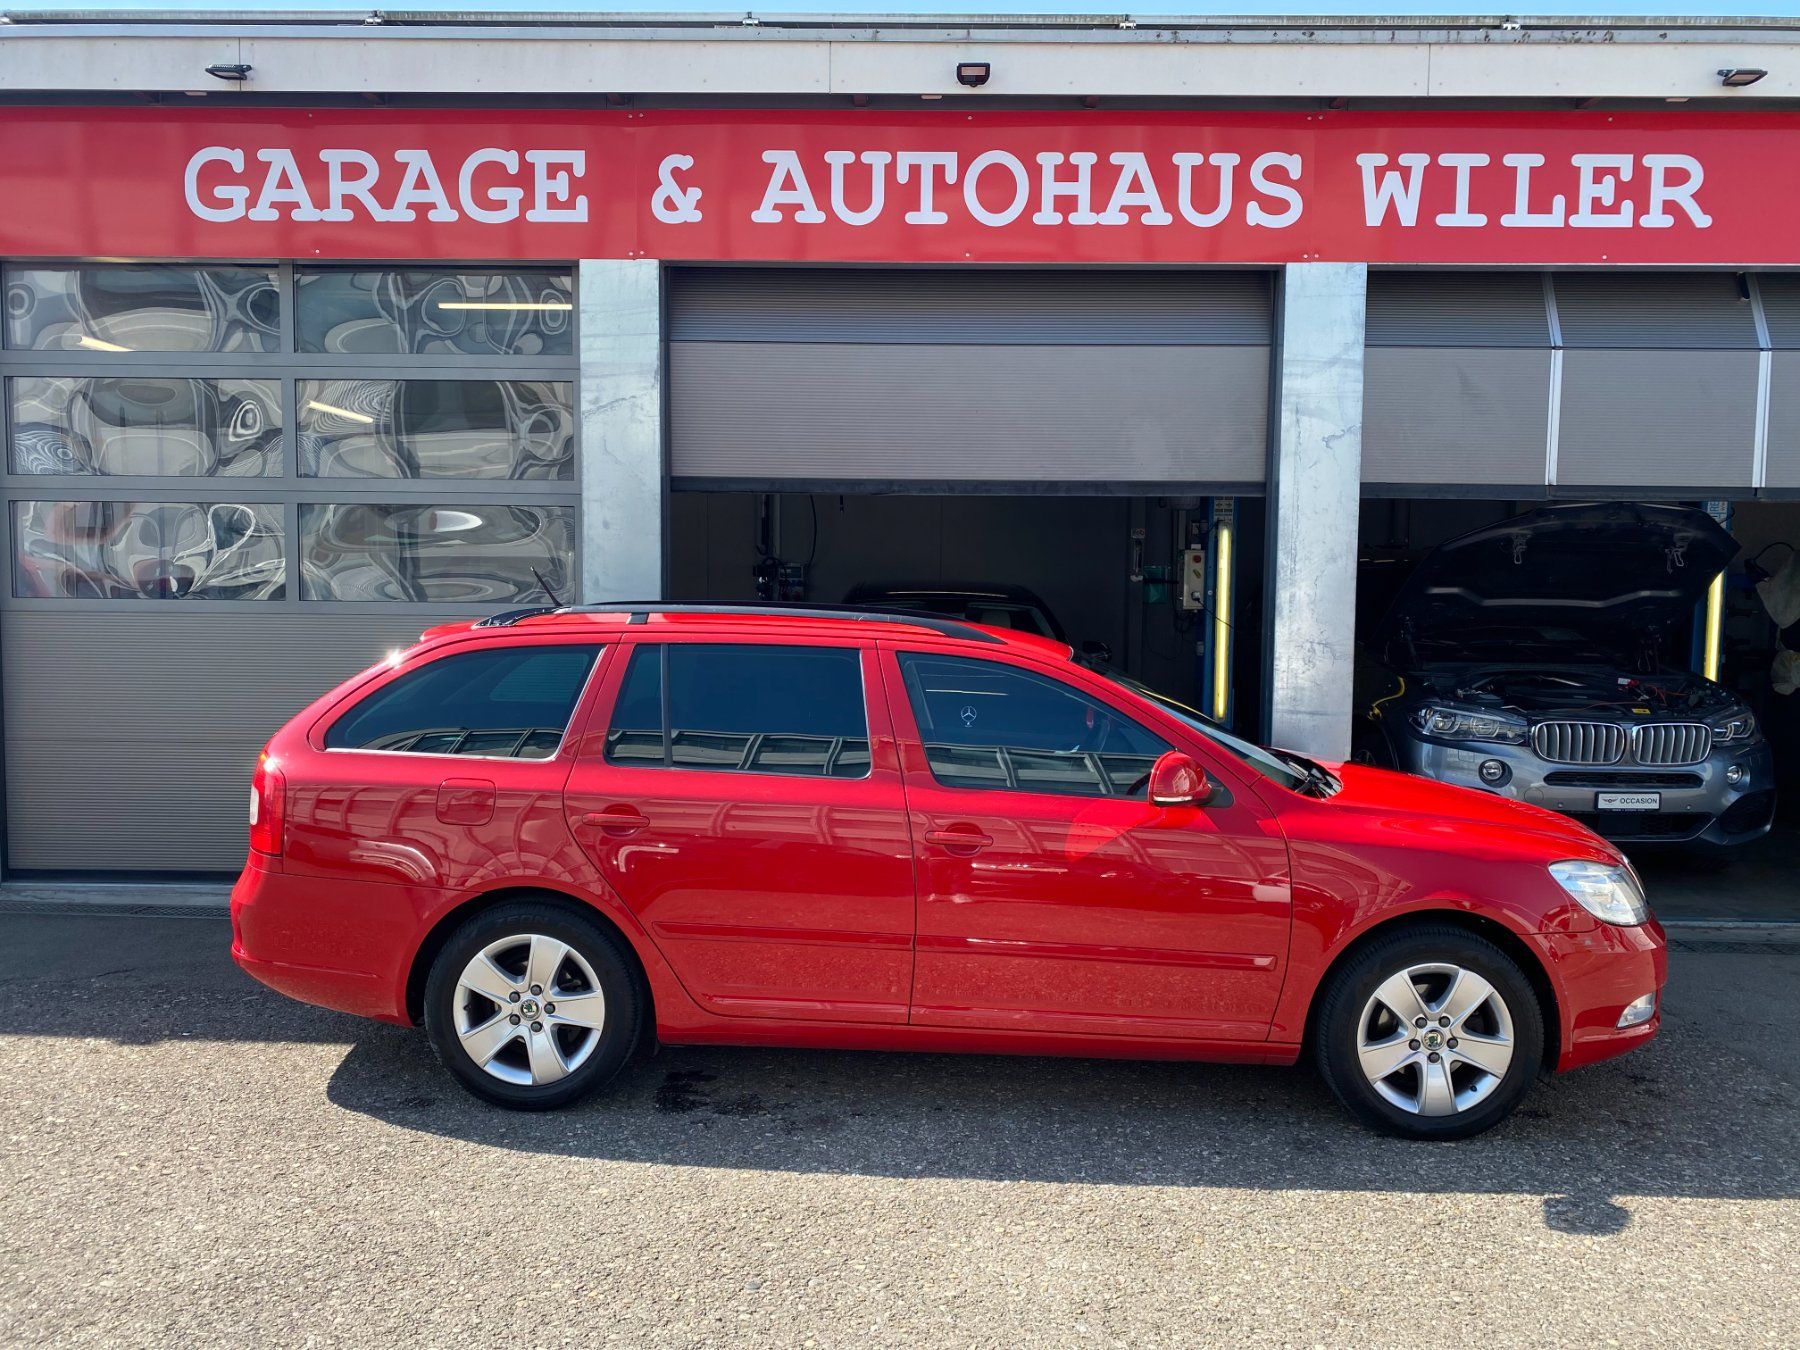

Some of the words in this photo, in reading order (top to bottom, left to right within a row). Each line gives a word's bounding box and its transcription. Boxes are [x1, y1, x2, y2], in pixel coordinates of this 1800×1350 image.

[185, 146, 588, 224] GARAGE
[650, 154, 703, 225] &
[750, 150, 1304, 229] AUTOHAUS
[1356, 152, 1713, 229] WILER
[1619, 797, 1658, 805] OCCASION
